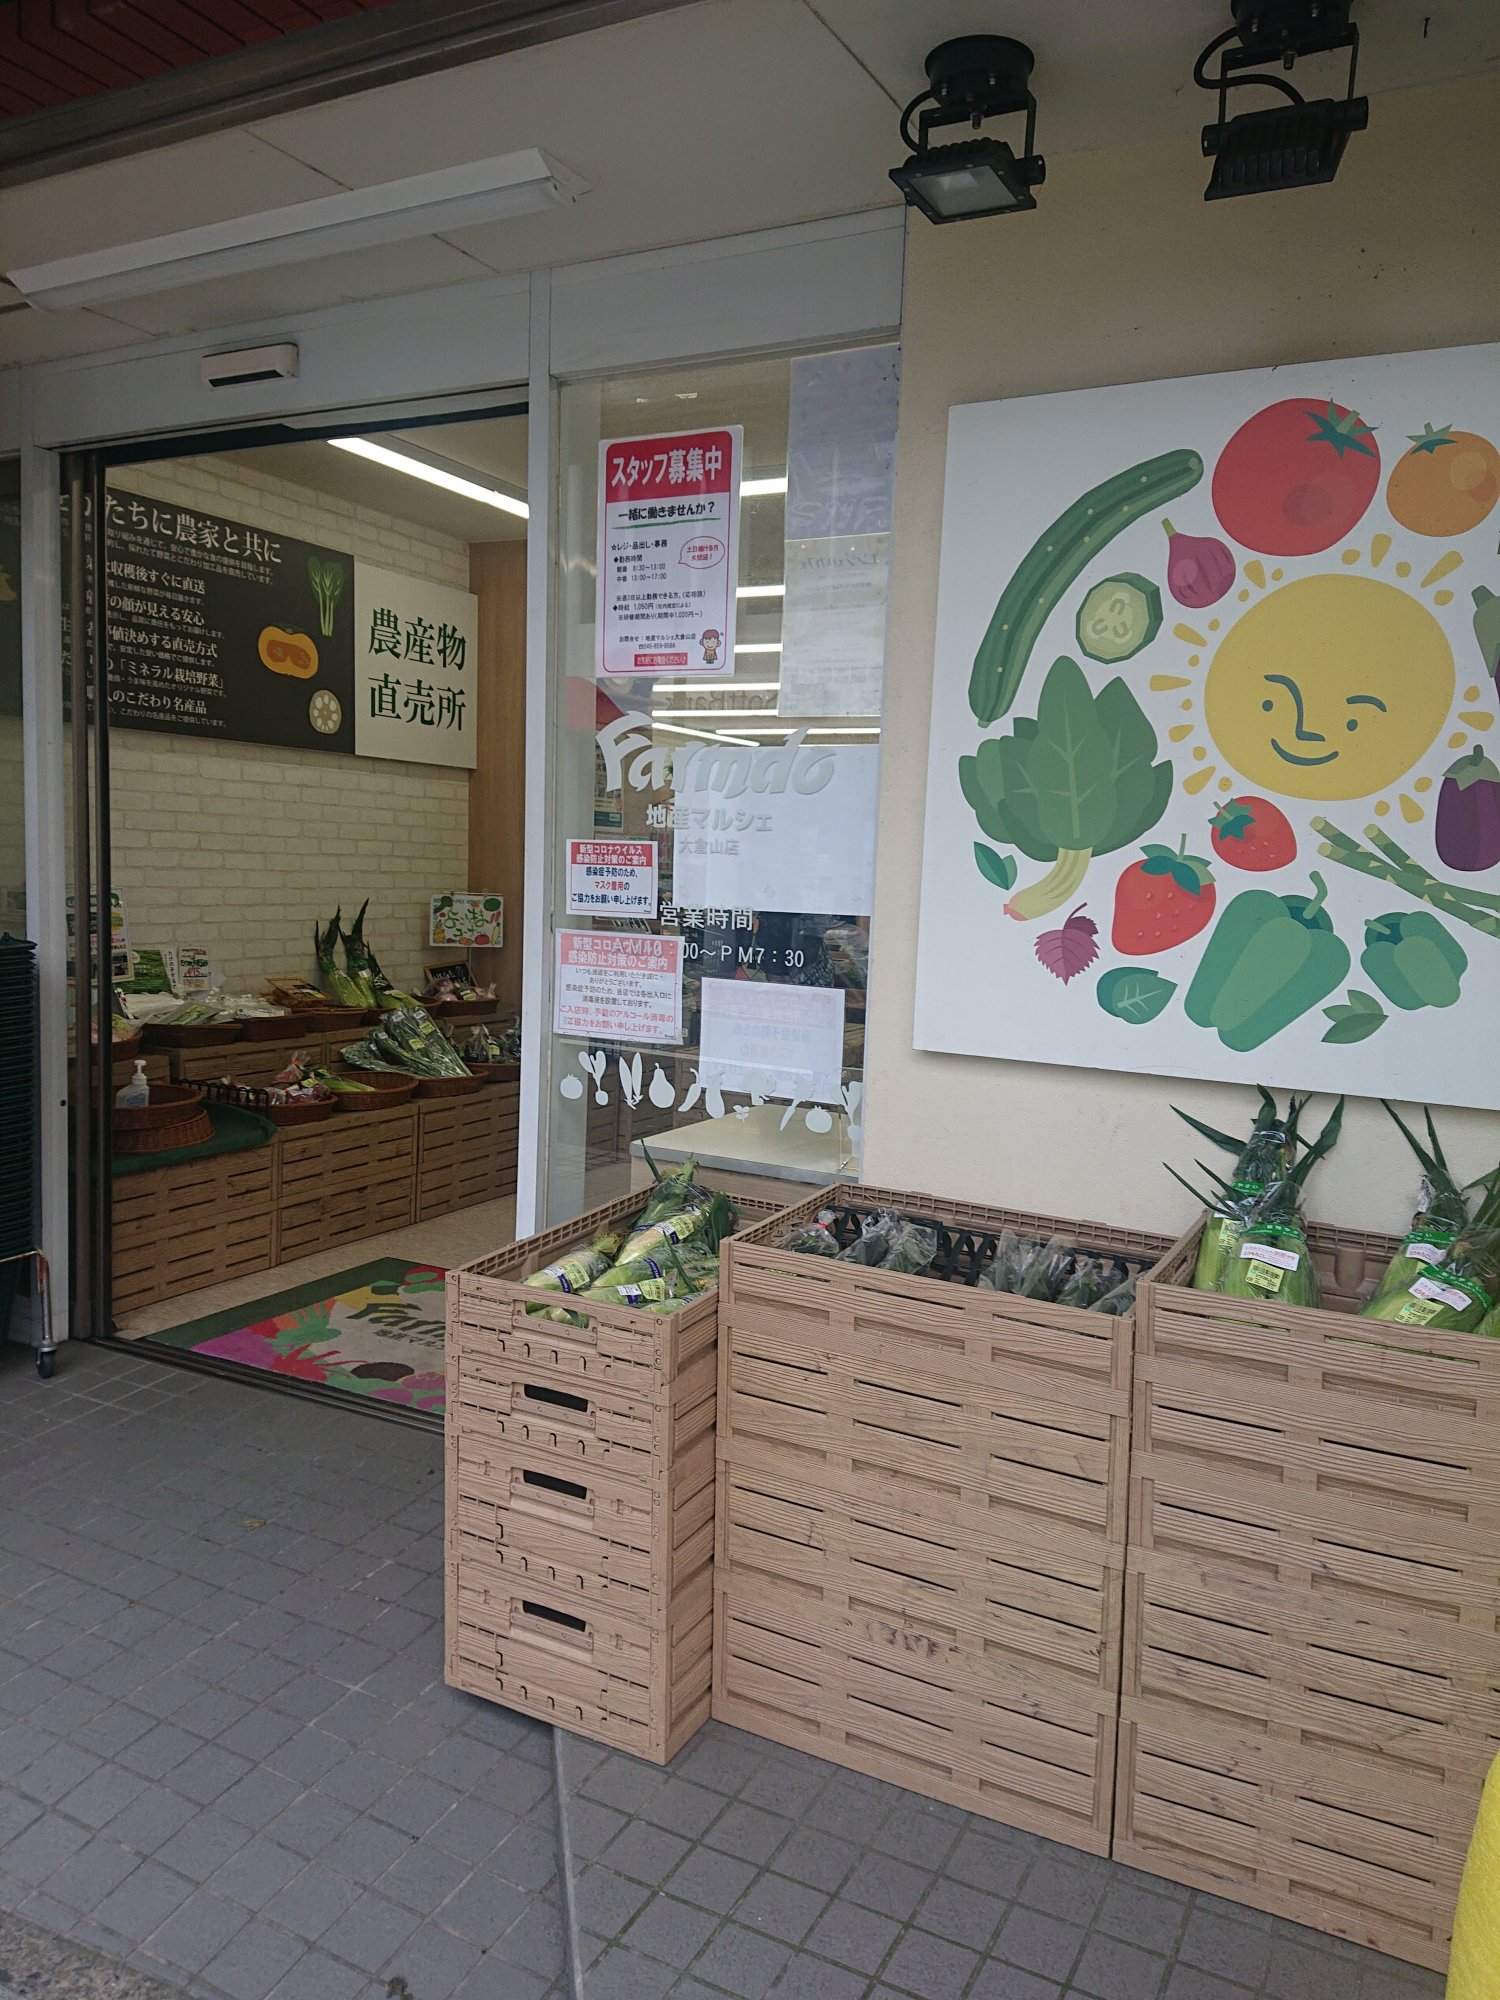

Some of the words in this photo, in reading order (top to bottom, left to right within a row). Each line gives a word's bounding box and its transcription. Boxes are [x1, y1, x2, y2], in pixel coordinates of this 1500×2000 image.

[611, 445, 723, 488] スタッフ募集中
[618, 501, 715, 521] 一緒に働きませんか？
[106, 594, 205, 626] の顔が見える安心
[368, 607, 467, 672] 農産物
[368, 672, 467, 732] 直売所
[596, 711, 837, 799] Farmdo
[646, 804, 773, 832] 地産マルシェ
[576, 854, 647, 866] 感染防止対策のご案内
[579, 844, 643, 855] 新型コロナウイルス
[680, 839, 740, 856] 大倉山店
[586, 867, 639, 878] 感染症予防のため、
[660, 904, 753, 931] 営業時間
[568, 951, 668, 971] 感染防止対策のご案内
